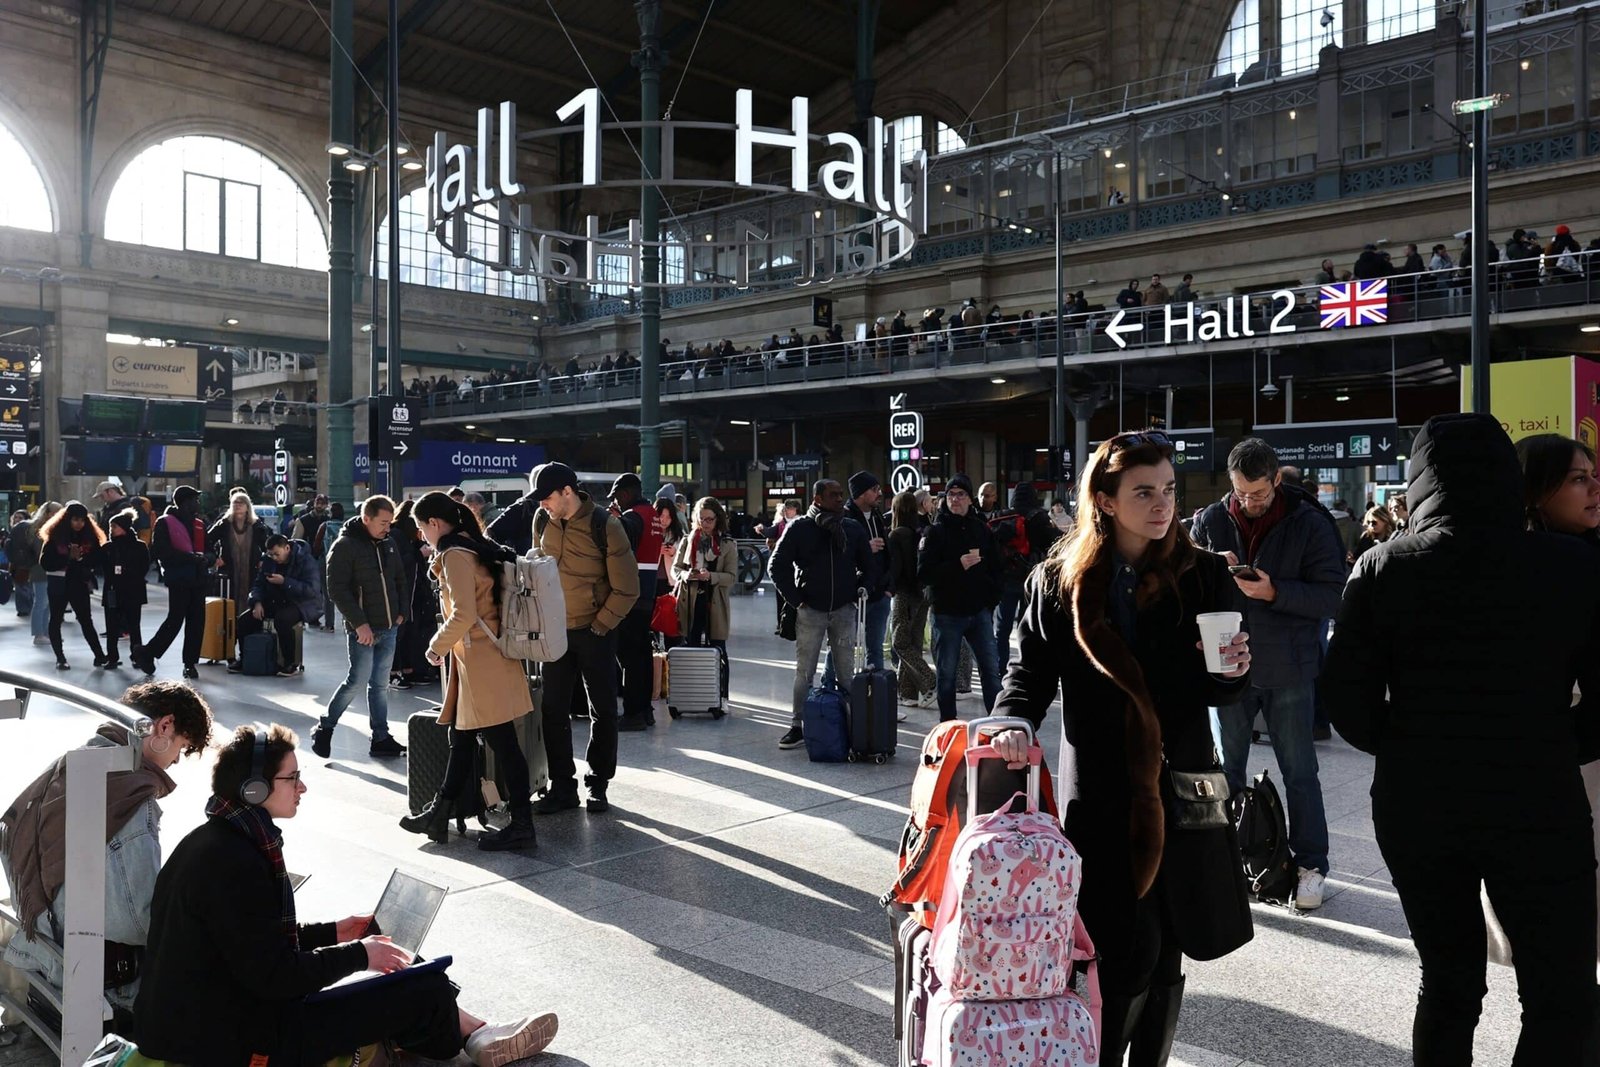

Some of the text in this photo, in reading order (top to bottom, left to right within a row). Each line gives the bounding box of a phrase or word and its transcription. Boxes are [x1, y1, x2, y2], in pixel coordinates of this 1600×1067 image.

[425, 100, 522, 222] Hall
[555, 88, 601, 186] 1
[735, 88, 908, 218] Hall
[1164, 289, 1297, 344] Hall 2
[132, 361, 186, 373] eurostar
[141, 381, 169, 390] Londres
[894, 422, 915, 438] RER
[1520, 416, 1549, 431] taxi
[1308, 443, 1335, 452] Sortie
[451, 451, 517, 467] donnant
